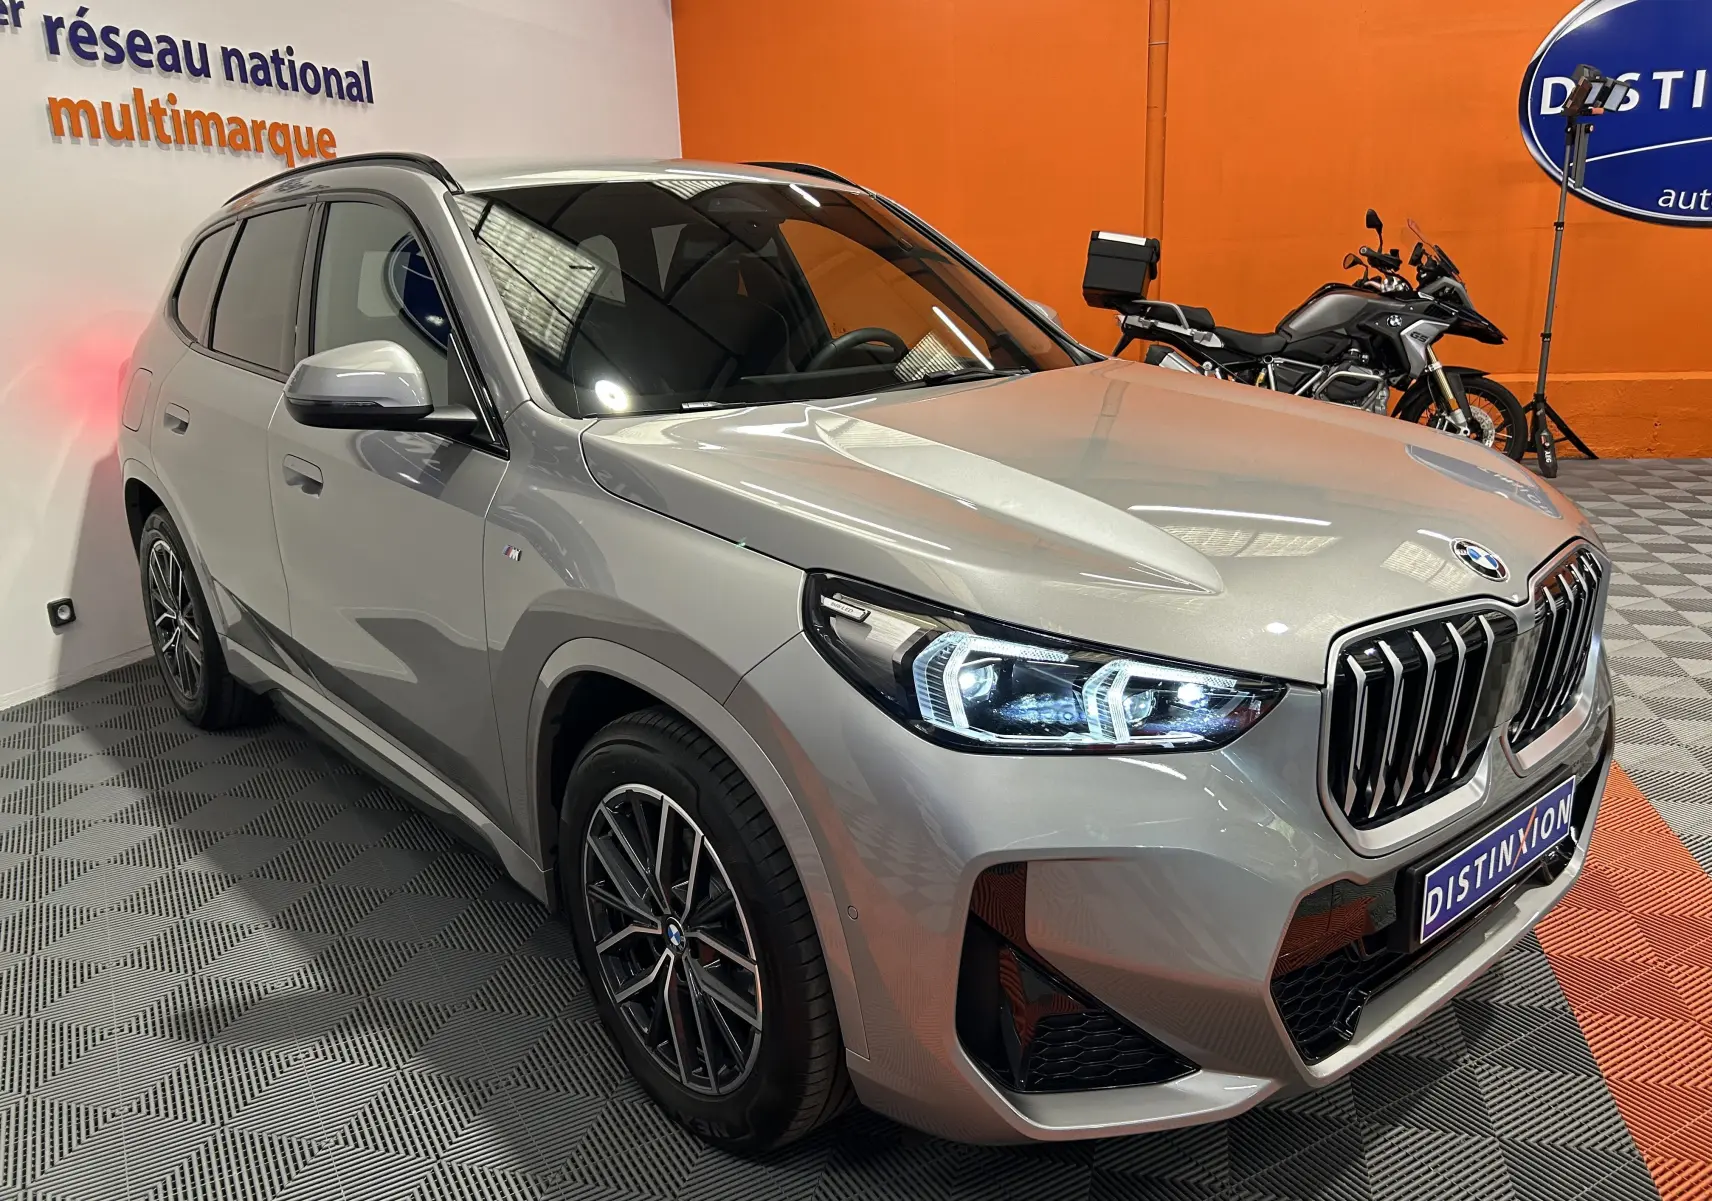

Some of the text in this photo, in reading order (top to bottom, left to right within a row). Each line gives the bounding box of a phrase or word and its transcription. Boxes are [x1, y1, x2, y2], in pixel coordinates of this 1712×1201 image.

[43, 6, 211, 79] réseau
[221, 45, 374, 104] national
[1540, 69, 1707, 115] DSTI
[48, 88, 337, 168] multimarque
[1658, 189, 1712, 210] aut
[1410, 331, 1429, 343] GS
[1426, 794, 1572, 925] DISTINXION
